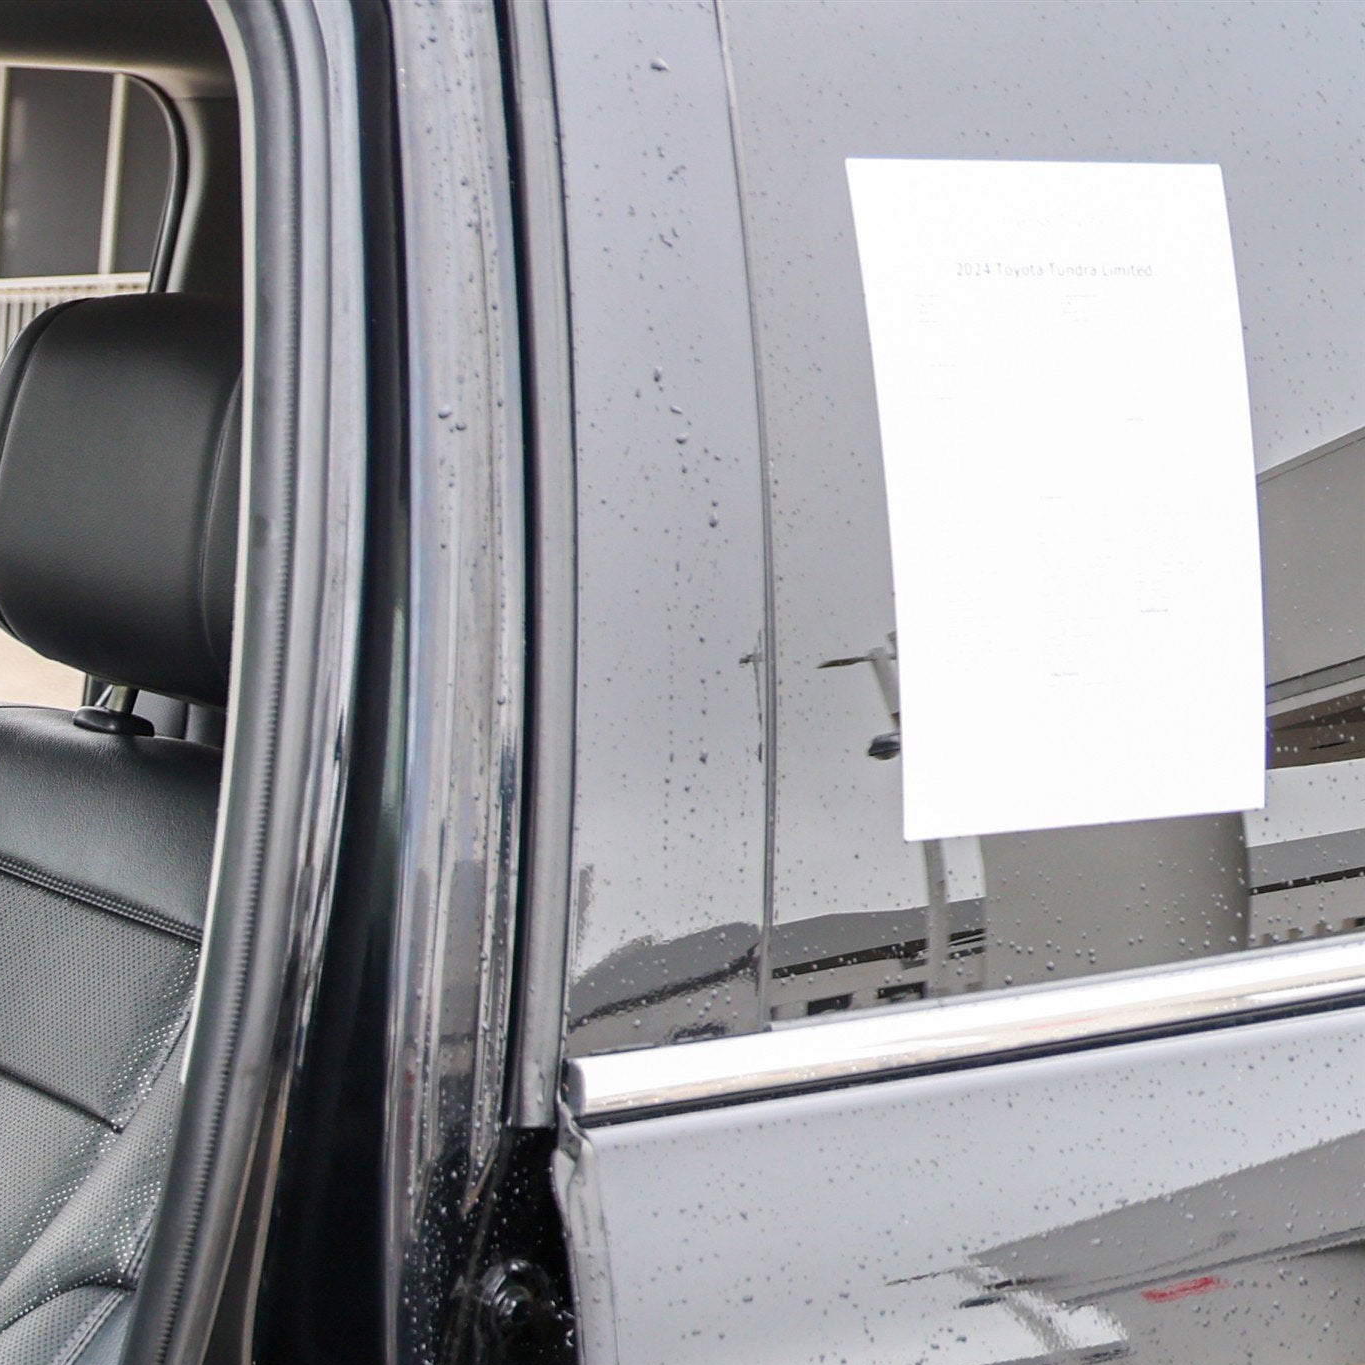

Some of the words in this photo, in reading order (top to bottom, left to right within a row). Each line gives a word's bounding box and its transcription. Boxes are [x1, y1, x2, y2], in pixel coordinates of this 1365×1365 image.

[956, 262, 991, 277] 2024
[996, 262, 1044, 278] Toyota
[1049, 262, 1097, 277] Tundra
[1101, 262, 1153, 278] Limited
